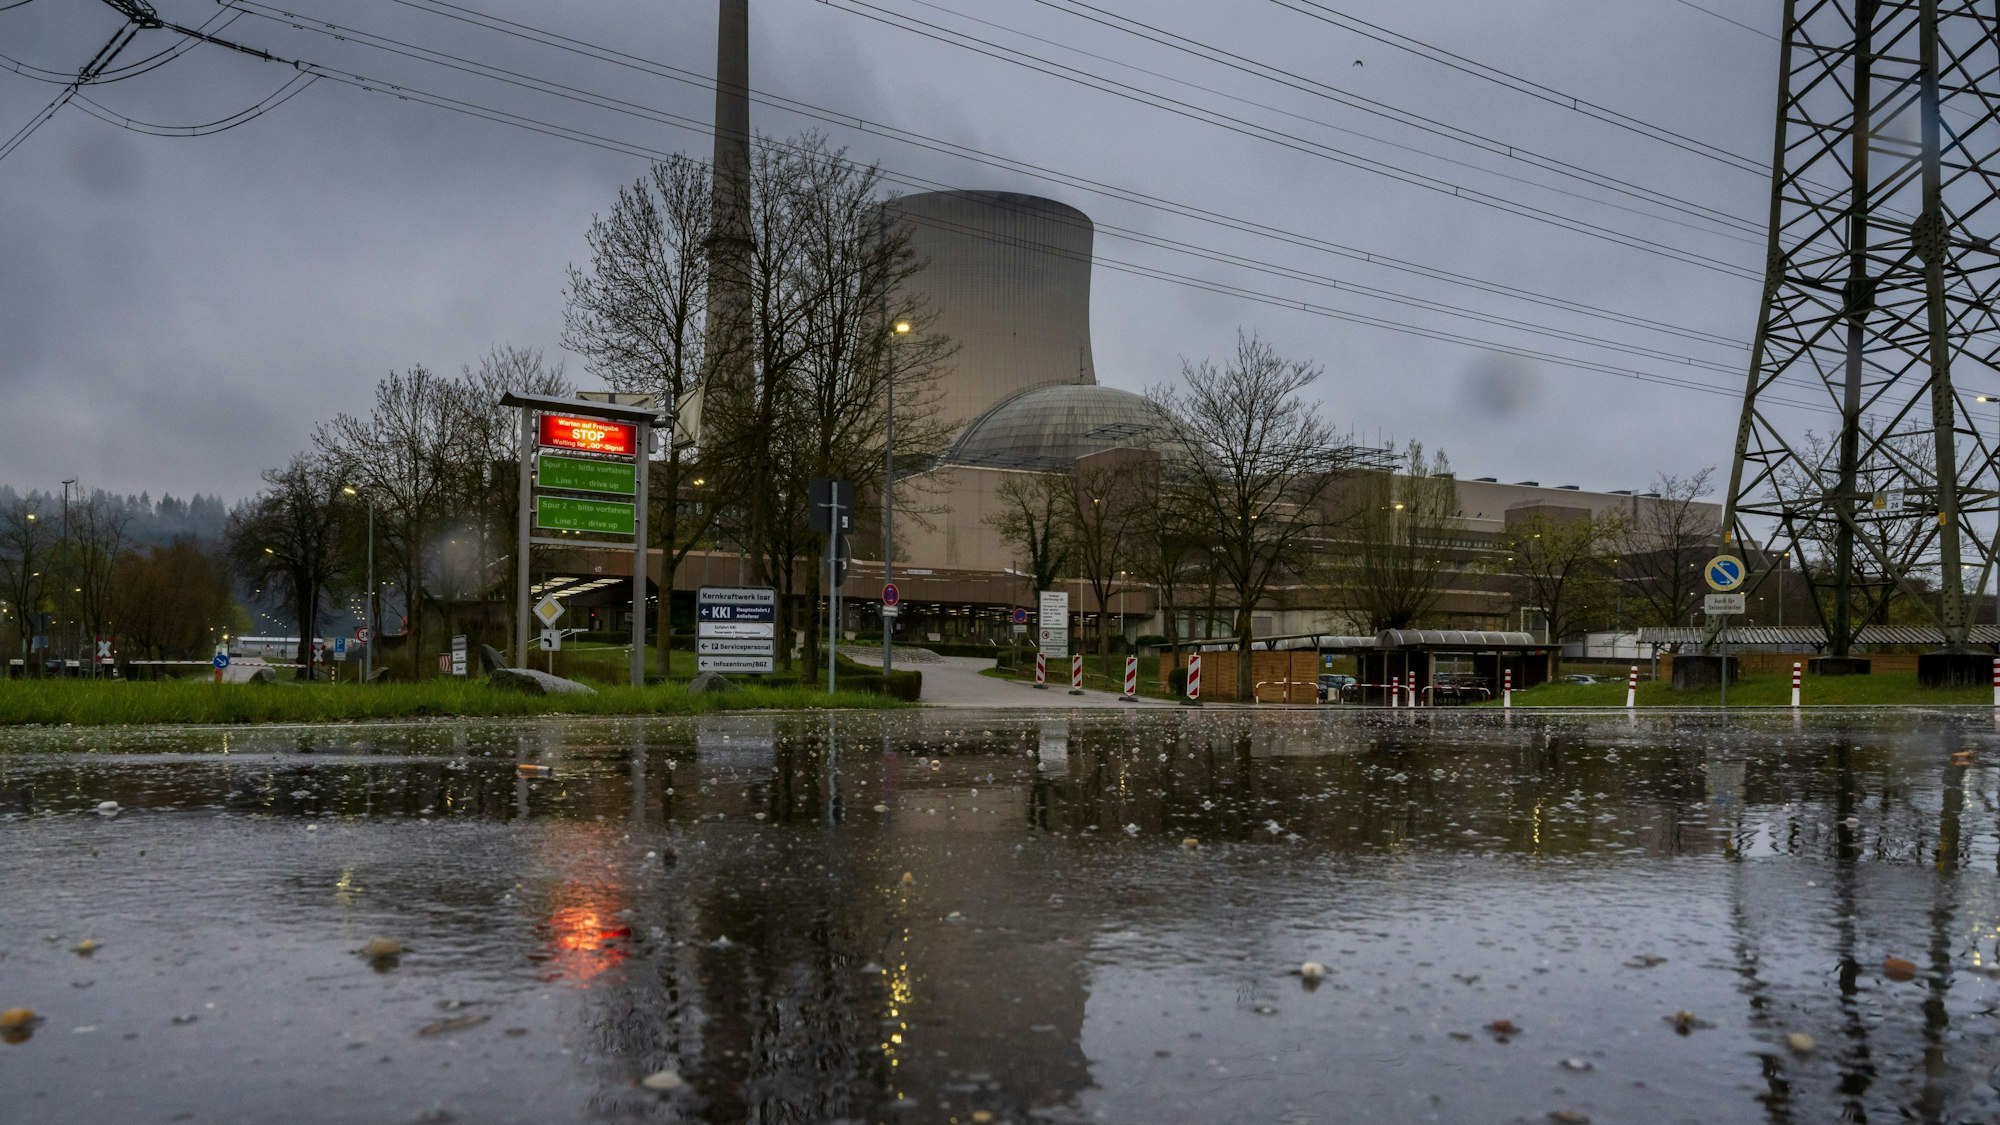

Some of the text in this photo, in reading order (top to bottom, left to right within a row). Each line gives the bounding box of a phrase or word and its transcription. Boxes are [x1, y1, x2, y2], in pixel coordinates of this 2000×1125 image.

[558, 419, 581, 427] Warten
[592, 423, 619, 432] Freigabe
[572, 428, 605, 442] STOP
[552, 438, 576, 448] Waiting
[543, 459, 561, 469] Spur
[578, 463, 595, 472] bitte
[596, 466, 632, 475] vorfahren
[555, 476, 572, 485] Line
[589, 480, 607, 488] drive
[609, 482, 619, 490] up
[542, 500, 560, 510] Spur
[577, 503, 594, 511] bitte
[595, 506, 631, 515] vorfahren
[554, 517, 572, 525] Line
[588, 520, 606, 528] drive
[702, 592, 756, 601] Kernkraftwerk
[712, 606, 731, 619] KKI
[720, 643, 771, 651] Servicepersonal
